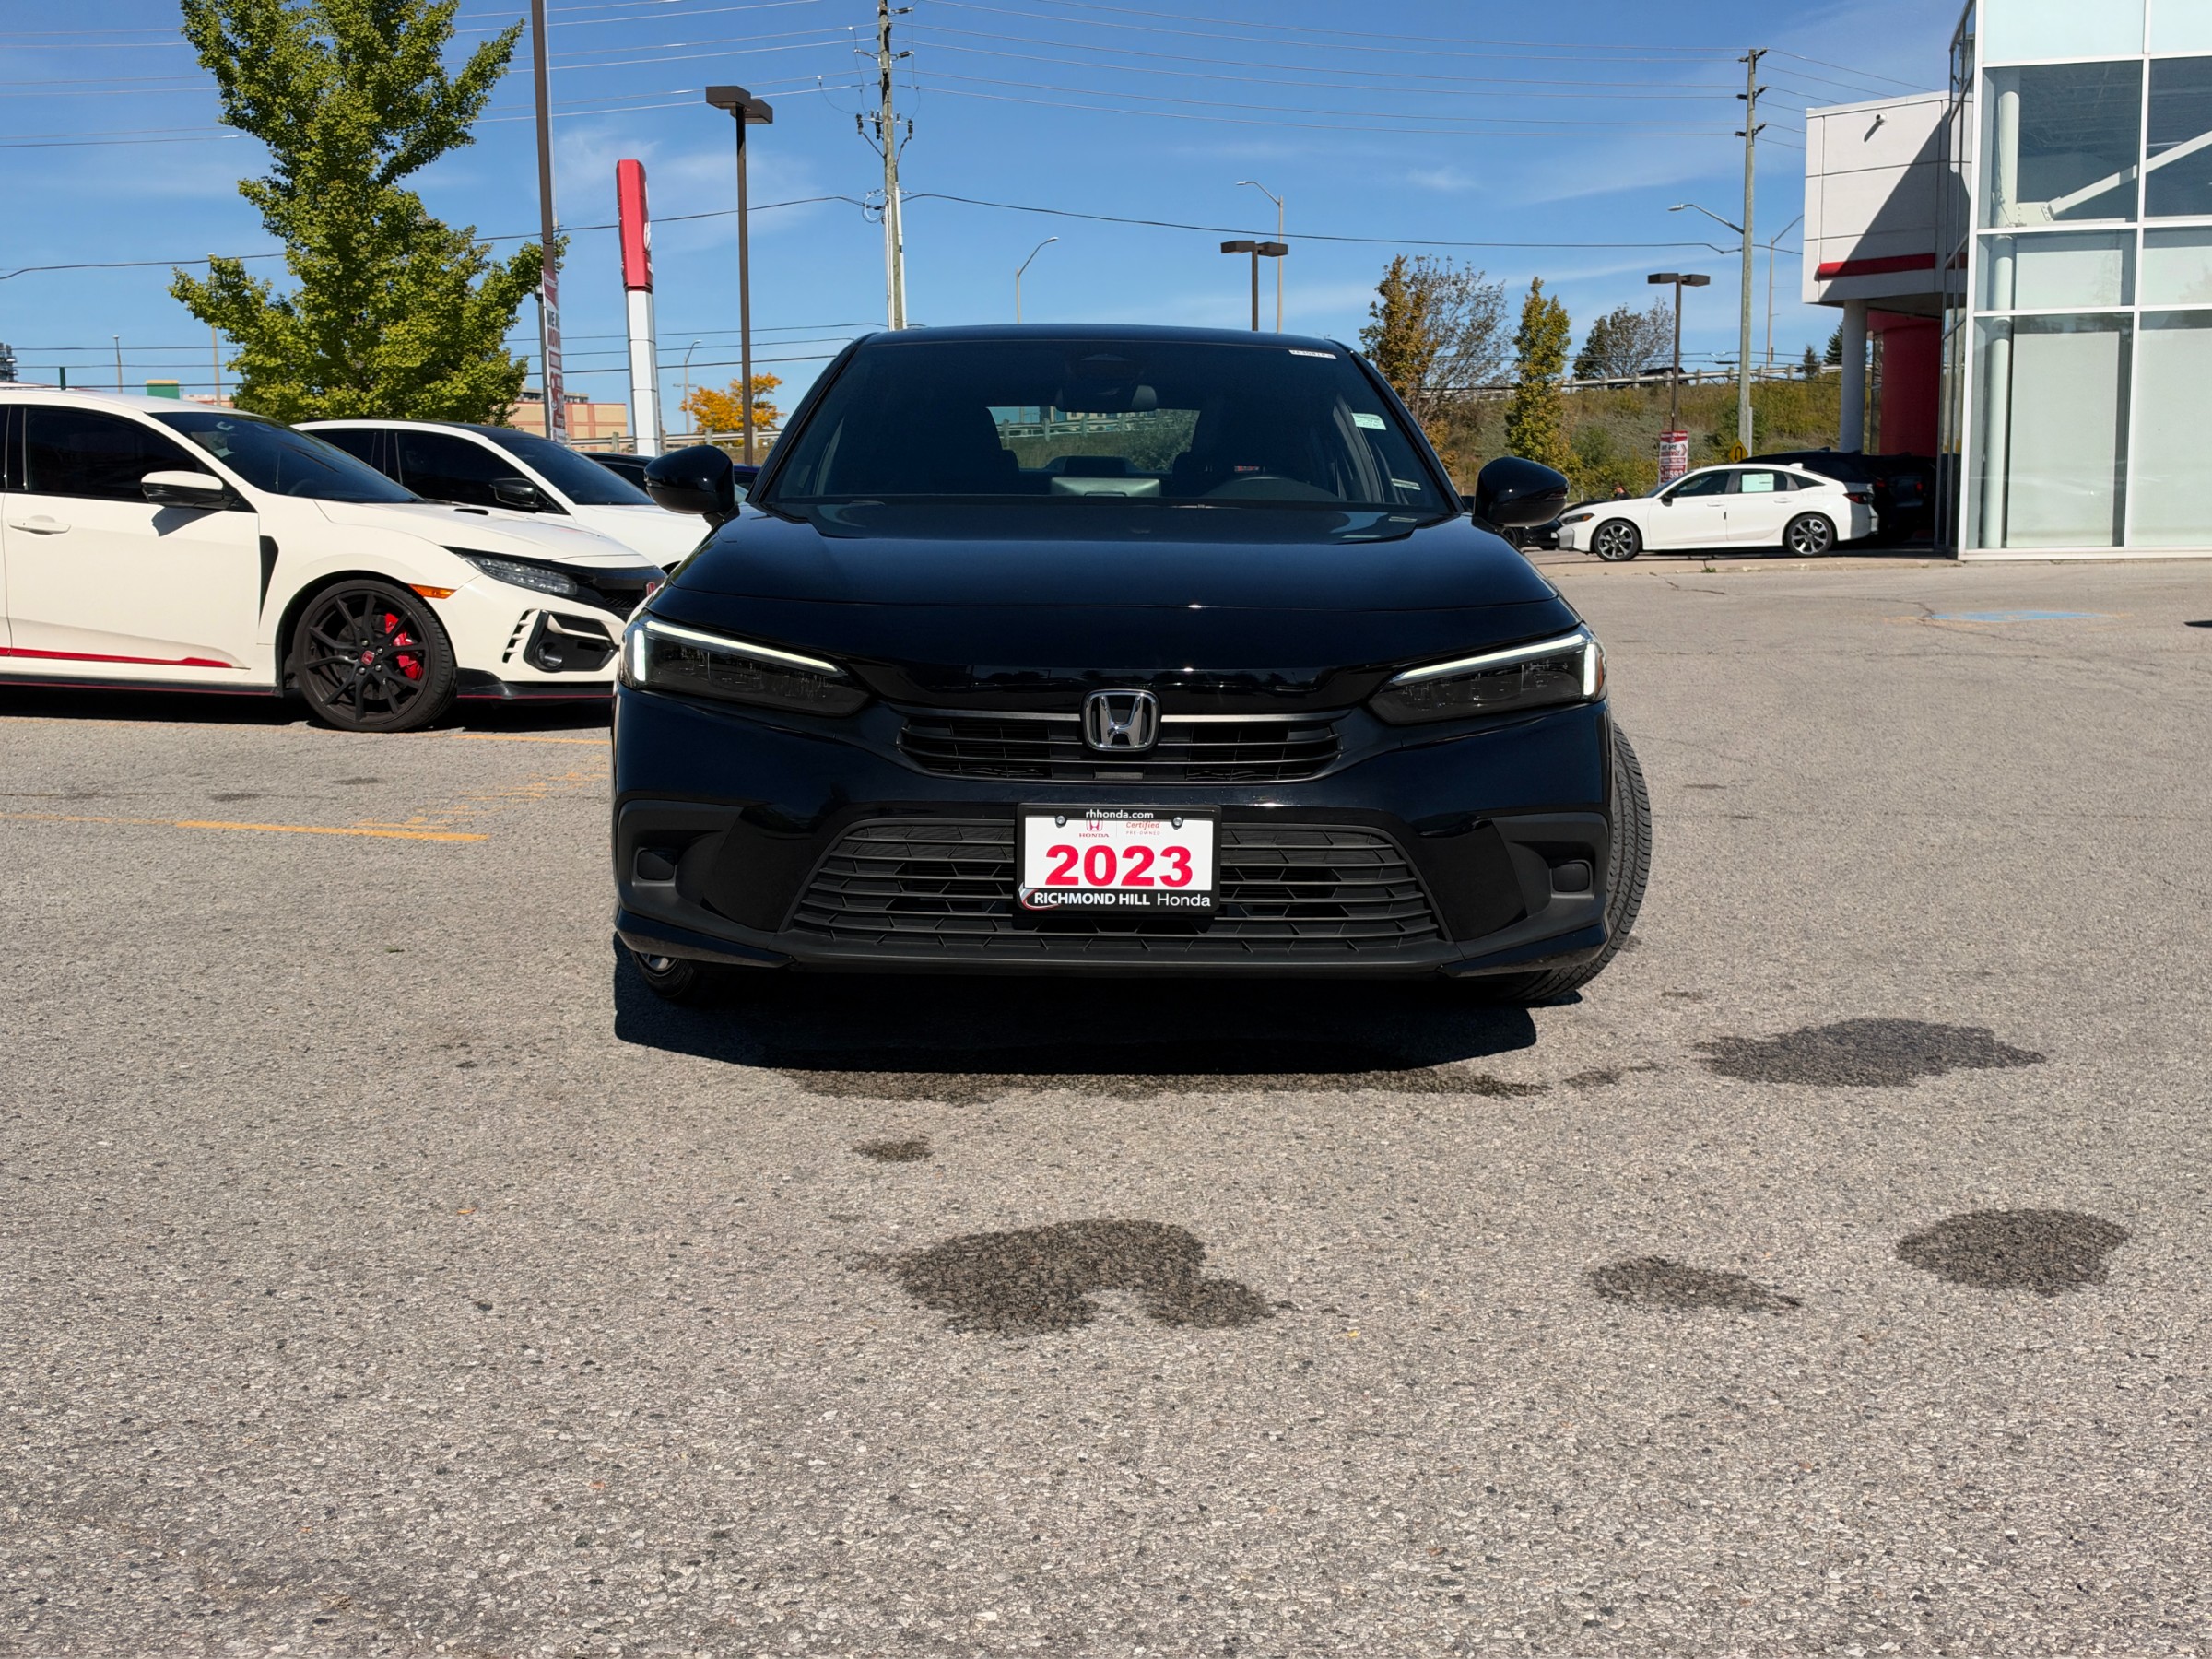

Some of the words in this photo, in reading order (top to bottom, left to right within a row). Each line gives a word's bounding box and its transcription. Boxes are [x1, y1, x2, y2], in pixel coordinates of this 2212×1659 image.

[1085, 809, 1154, 819] rhhonda.com
[1125, 821, 1160, 830] Certified
[1045, 844, 1193, 887] 2023
[1034, 892, 1116, 905] RICHMOND
[1119, 893, 1150, 906] HILL
[1157, 893, 1211, 907] Honda
